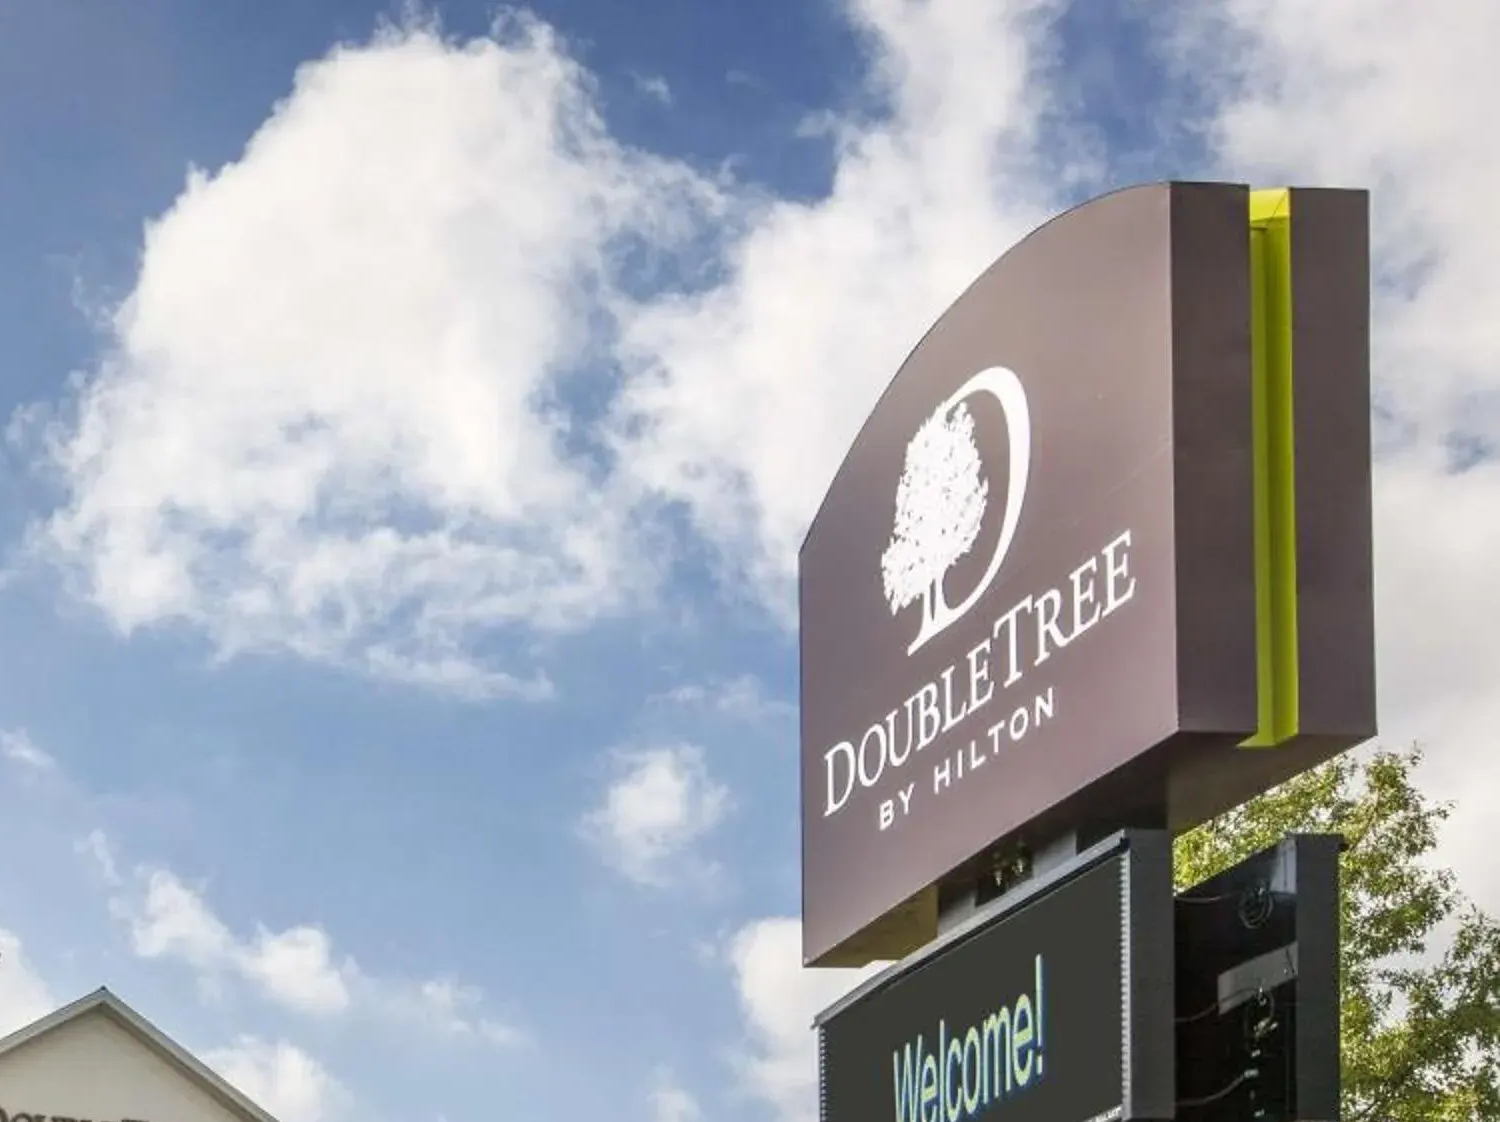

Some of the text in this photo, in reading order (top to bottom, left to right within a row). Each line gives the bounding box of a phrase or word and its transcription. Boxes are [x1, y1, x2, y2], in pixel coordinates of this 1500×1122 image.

[823, 529, 1137, 817] DOUBLETREE
[879, 687, 1055, 831] BY HILTON
